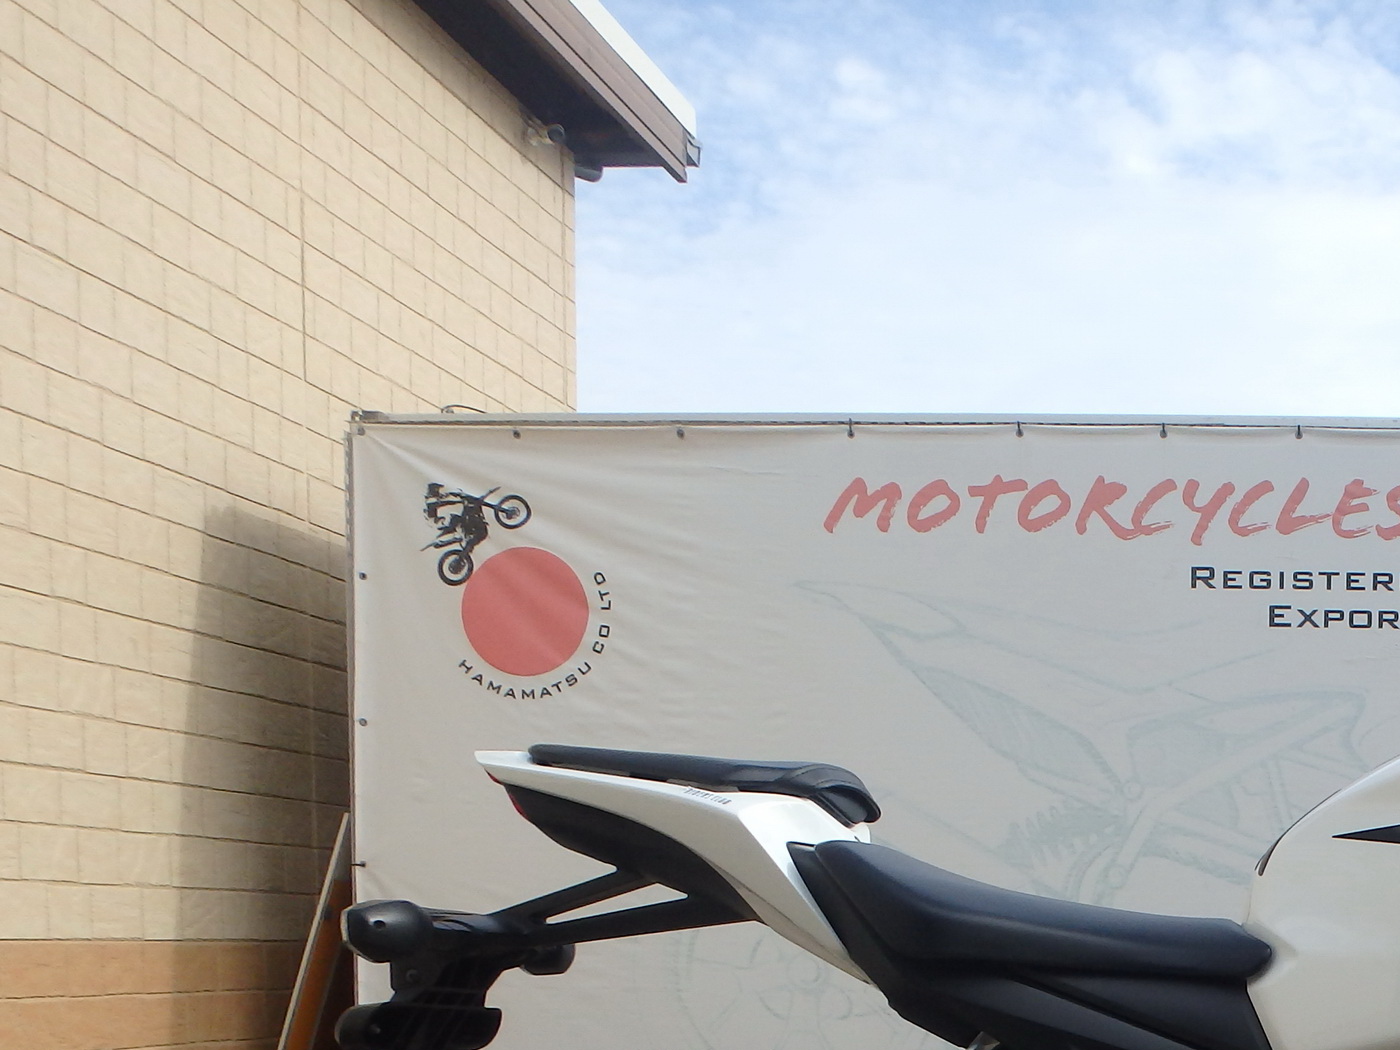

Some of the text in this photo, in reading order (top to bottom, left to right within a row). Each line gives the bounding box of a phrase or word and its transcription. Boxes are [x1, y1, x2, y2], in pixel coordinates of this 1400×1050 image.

[458, 571, 612, 700] HAMAMATSU CO LTD
